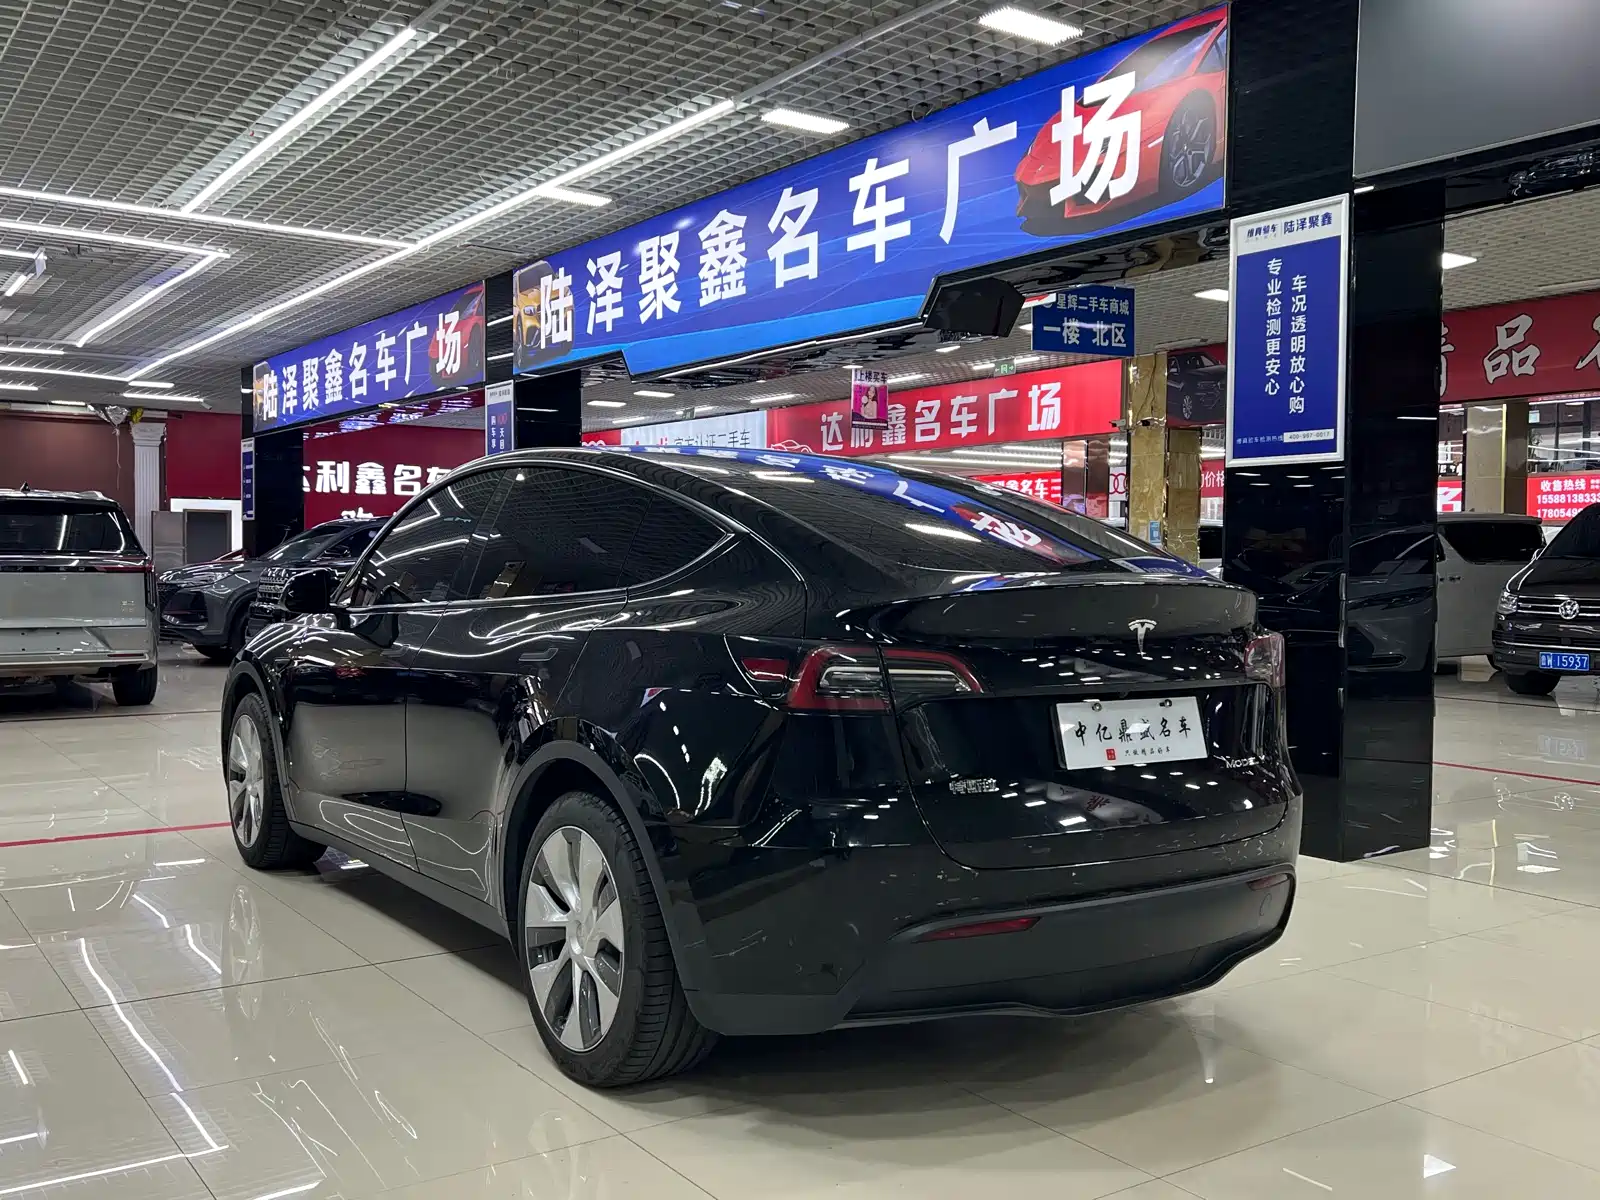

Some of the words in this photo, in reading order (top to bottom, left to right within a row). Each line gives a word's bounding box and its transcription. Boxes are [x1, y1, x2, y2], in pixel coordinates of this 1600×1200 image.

[539, 71, 1141, 348] 陆泽聚鑫名车广场
[1284, 212, 1332, 234] 陆泽聚鑫
[1043, 317, 1080, 345] 一楼
[1092, 321, 1126, 348] 北区
[1056, 293, 1130, 315] 星辉二手车商城
[1264, 258, 1283, 395] 专业检测更安心
[262, 310, 462, 423] 陆泽聚鑫名车广场
[1289, 274, 1307, 414] 车况透明放心购
[1540, 479, 1587, 492] 收售热线
